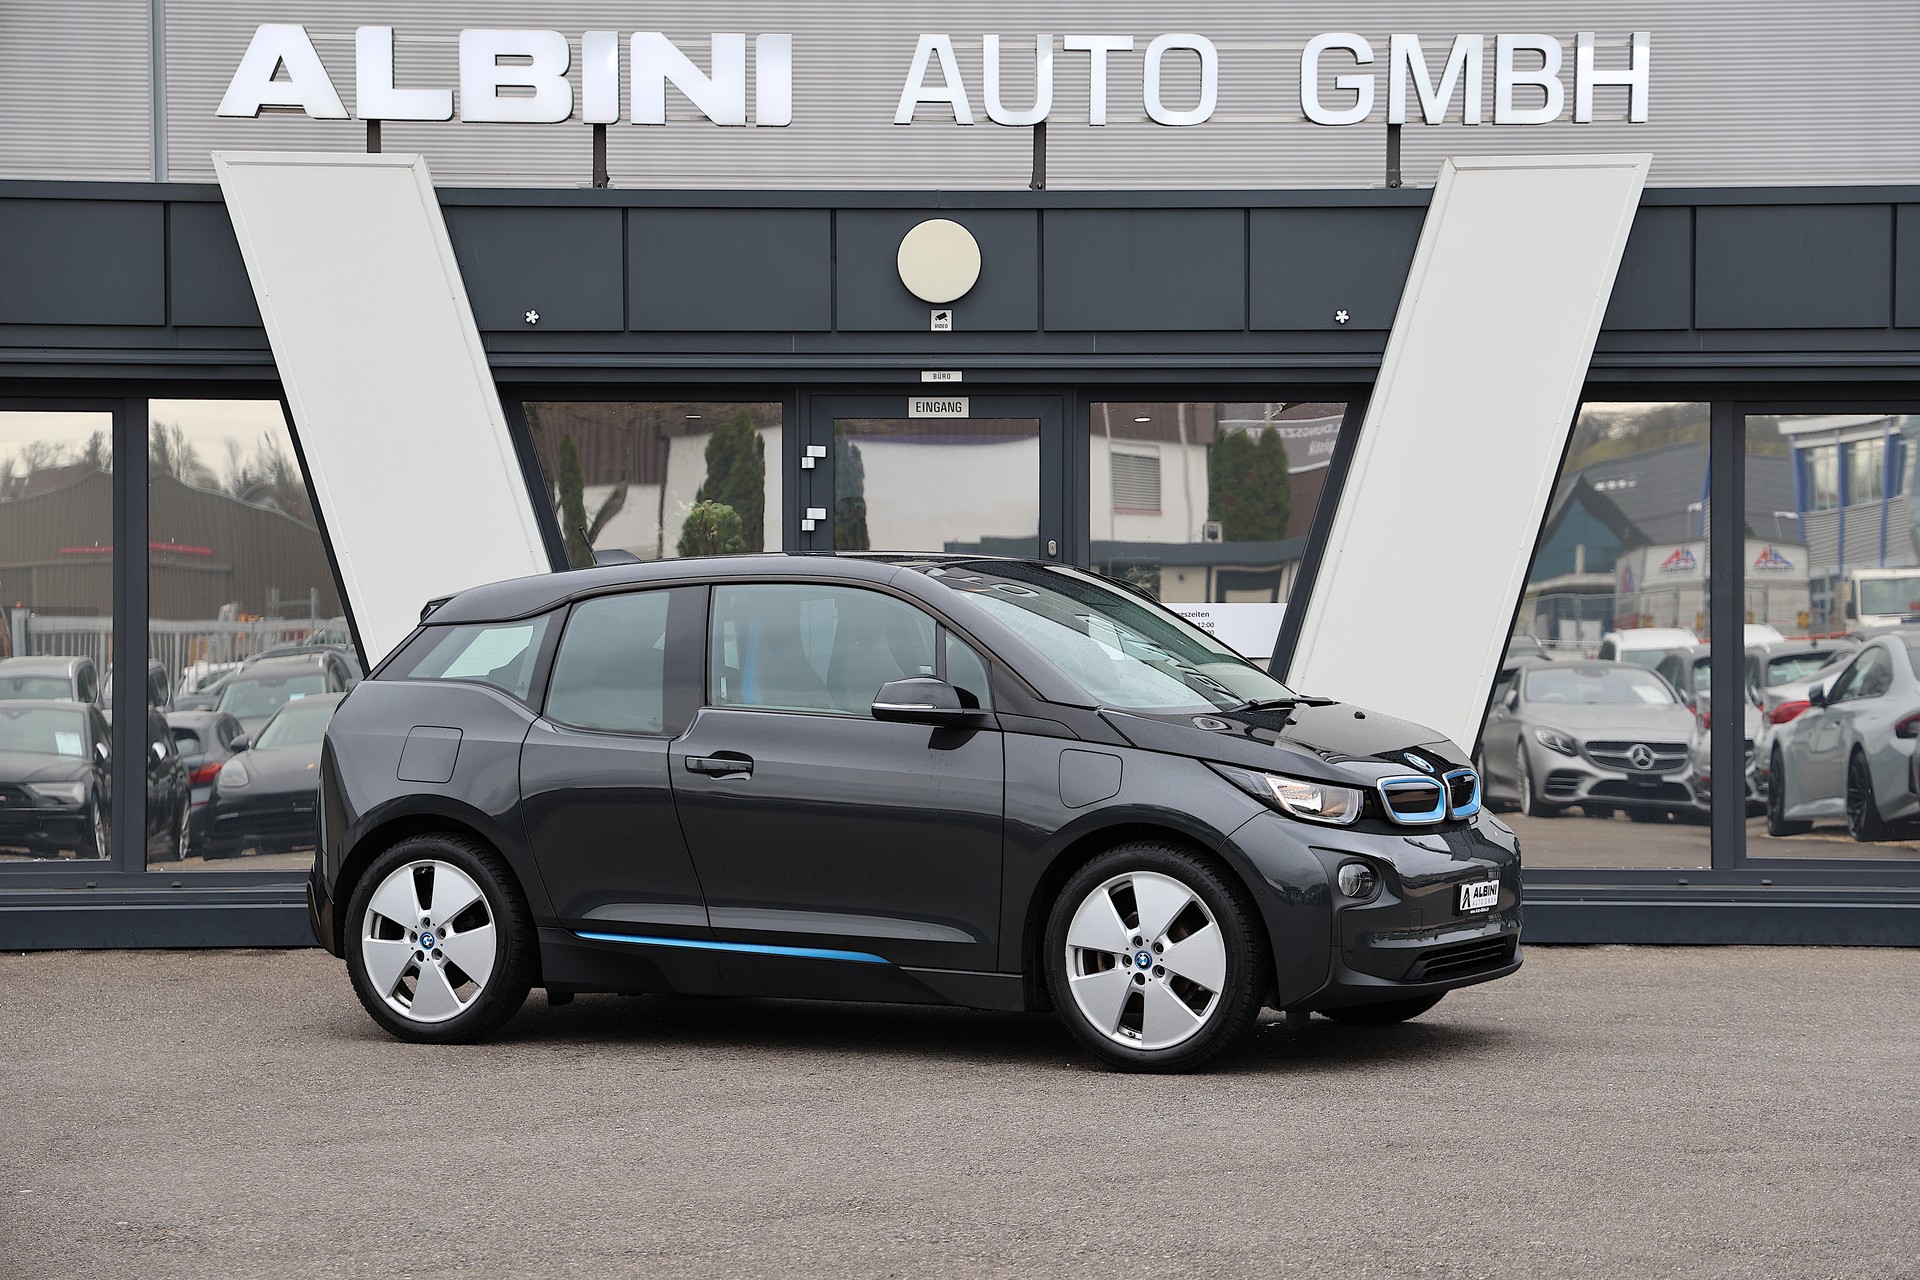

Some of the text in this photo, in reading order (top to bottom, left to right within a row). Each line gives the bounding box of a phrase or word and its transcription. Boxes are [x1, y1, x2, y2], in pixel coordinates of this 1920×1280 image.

[216, 23, 1651, 127] ALBINI AUTO GMBH
[932, 371, 951, 380] BÜRO
[915, 401, 962, 413] EINGANG
[1473, 884, 1497, 898] ALBINI
